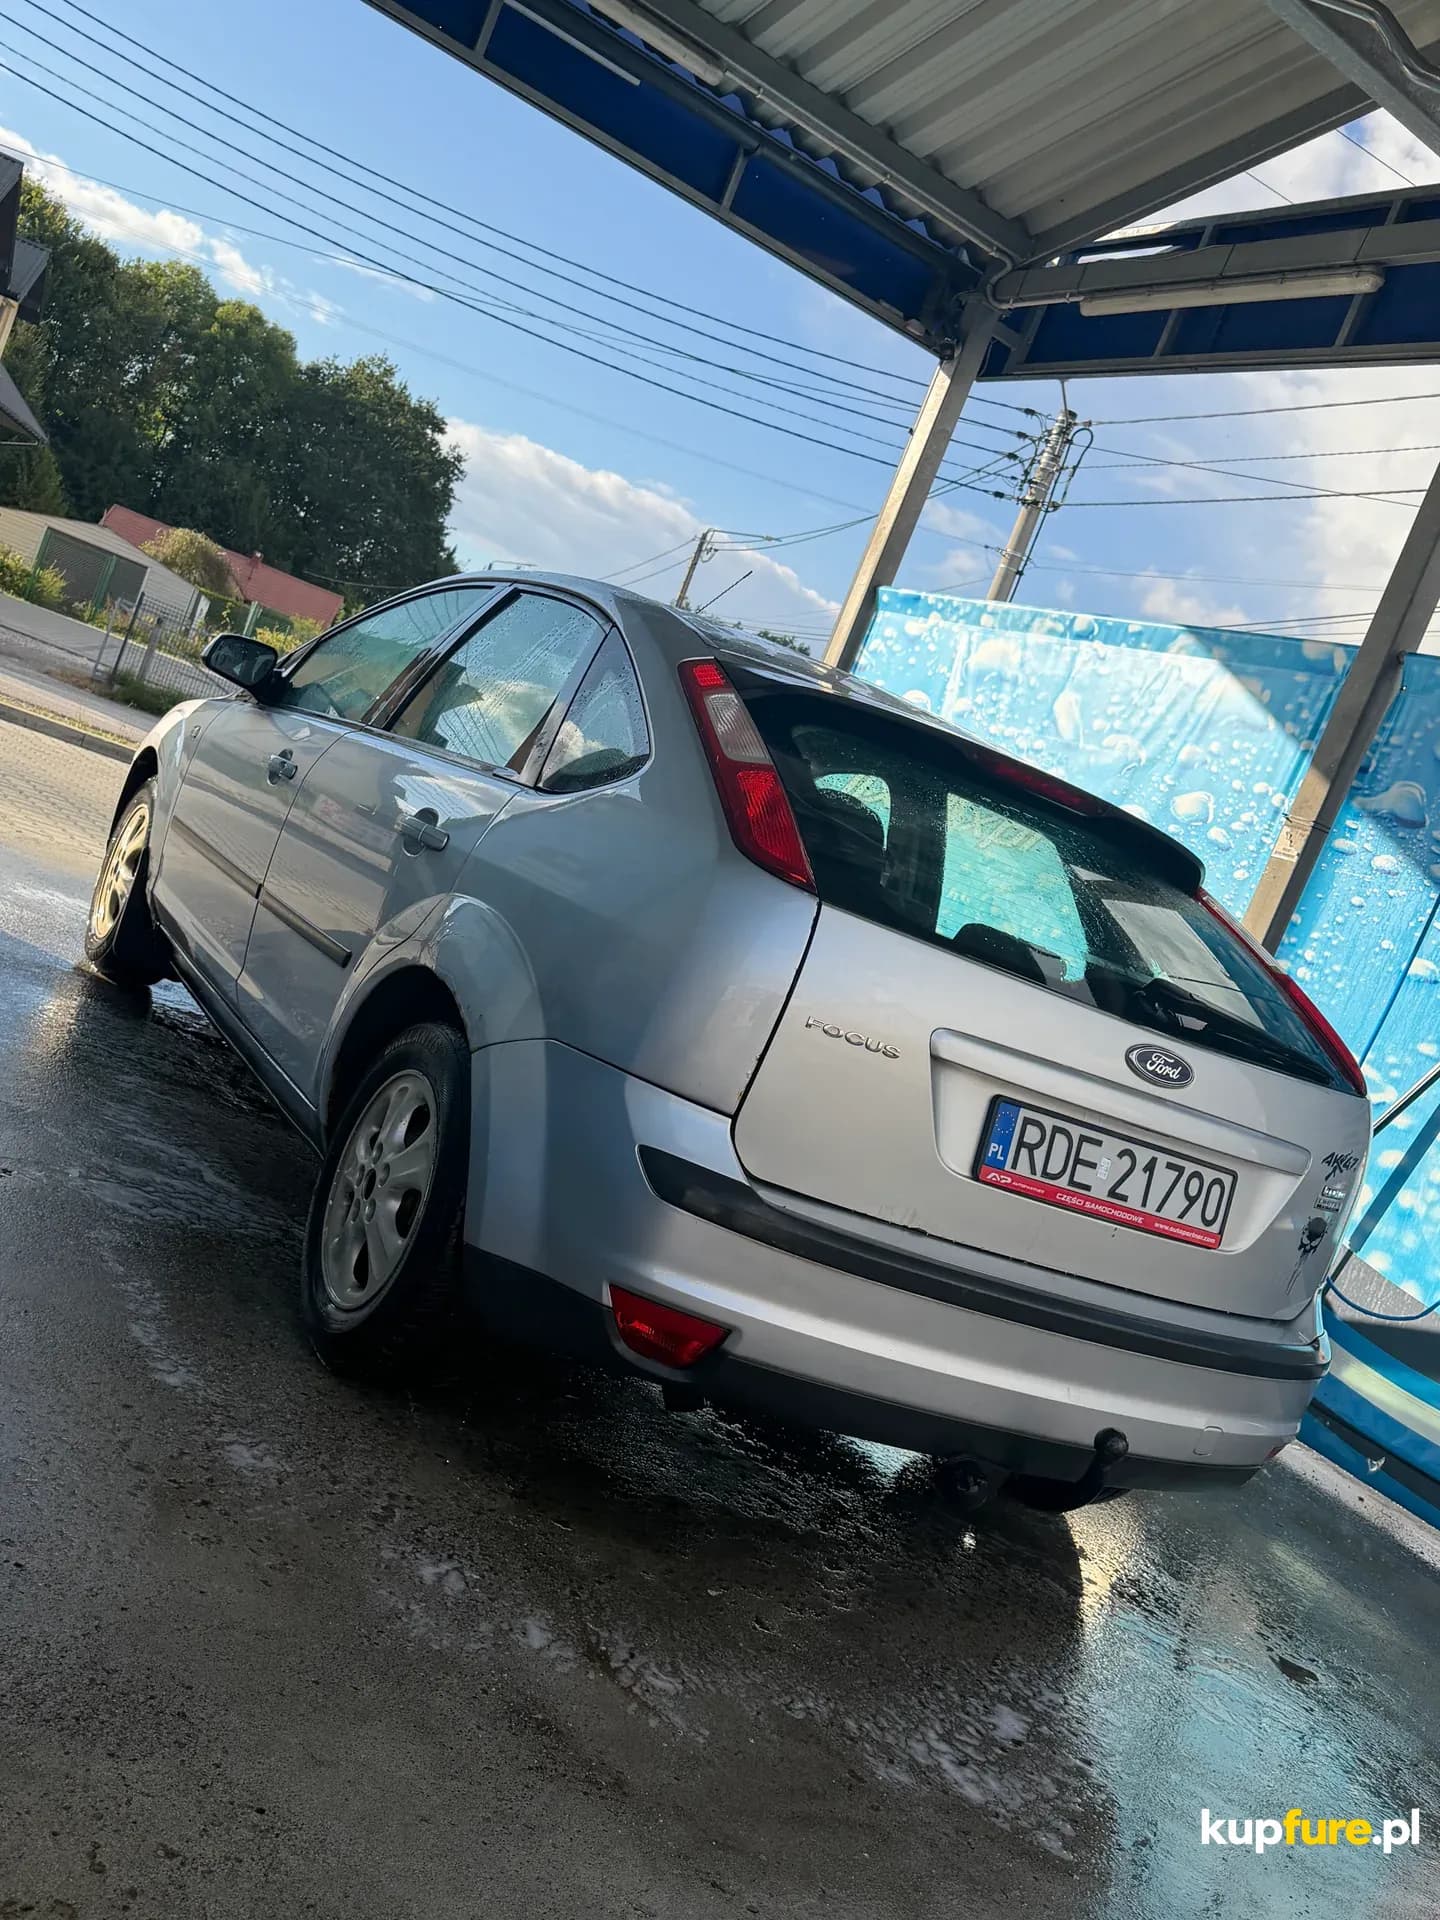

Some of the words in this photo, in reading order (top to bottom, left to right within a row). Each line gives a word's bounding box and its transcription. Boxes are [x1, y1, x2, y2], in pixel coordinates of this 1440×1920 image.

[804, 1016, 901, 1059] FOCUS
[1146, 1053, 1182, 1079] Ford
[988, 1142, 1004, 1160] PL
[1011, 1116, 1103, 1192] RDE
[1107, 1148, 1225, 1227] 21790
[1084, 1201, 1144, 1224] SAMOCHODOWE
